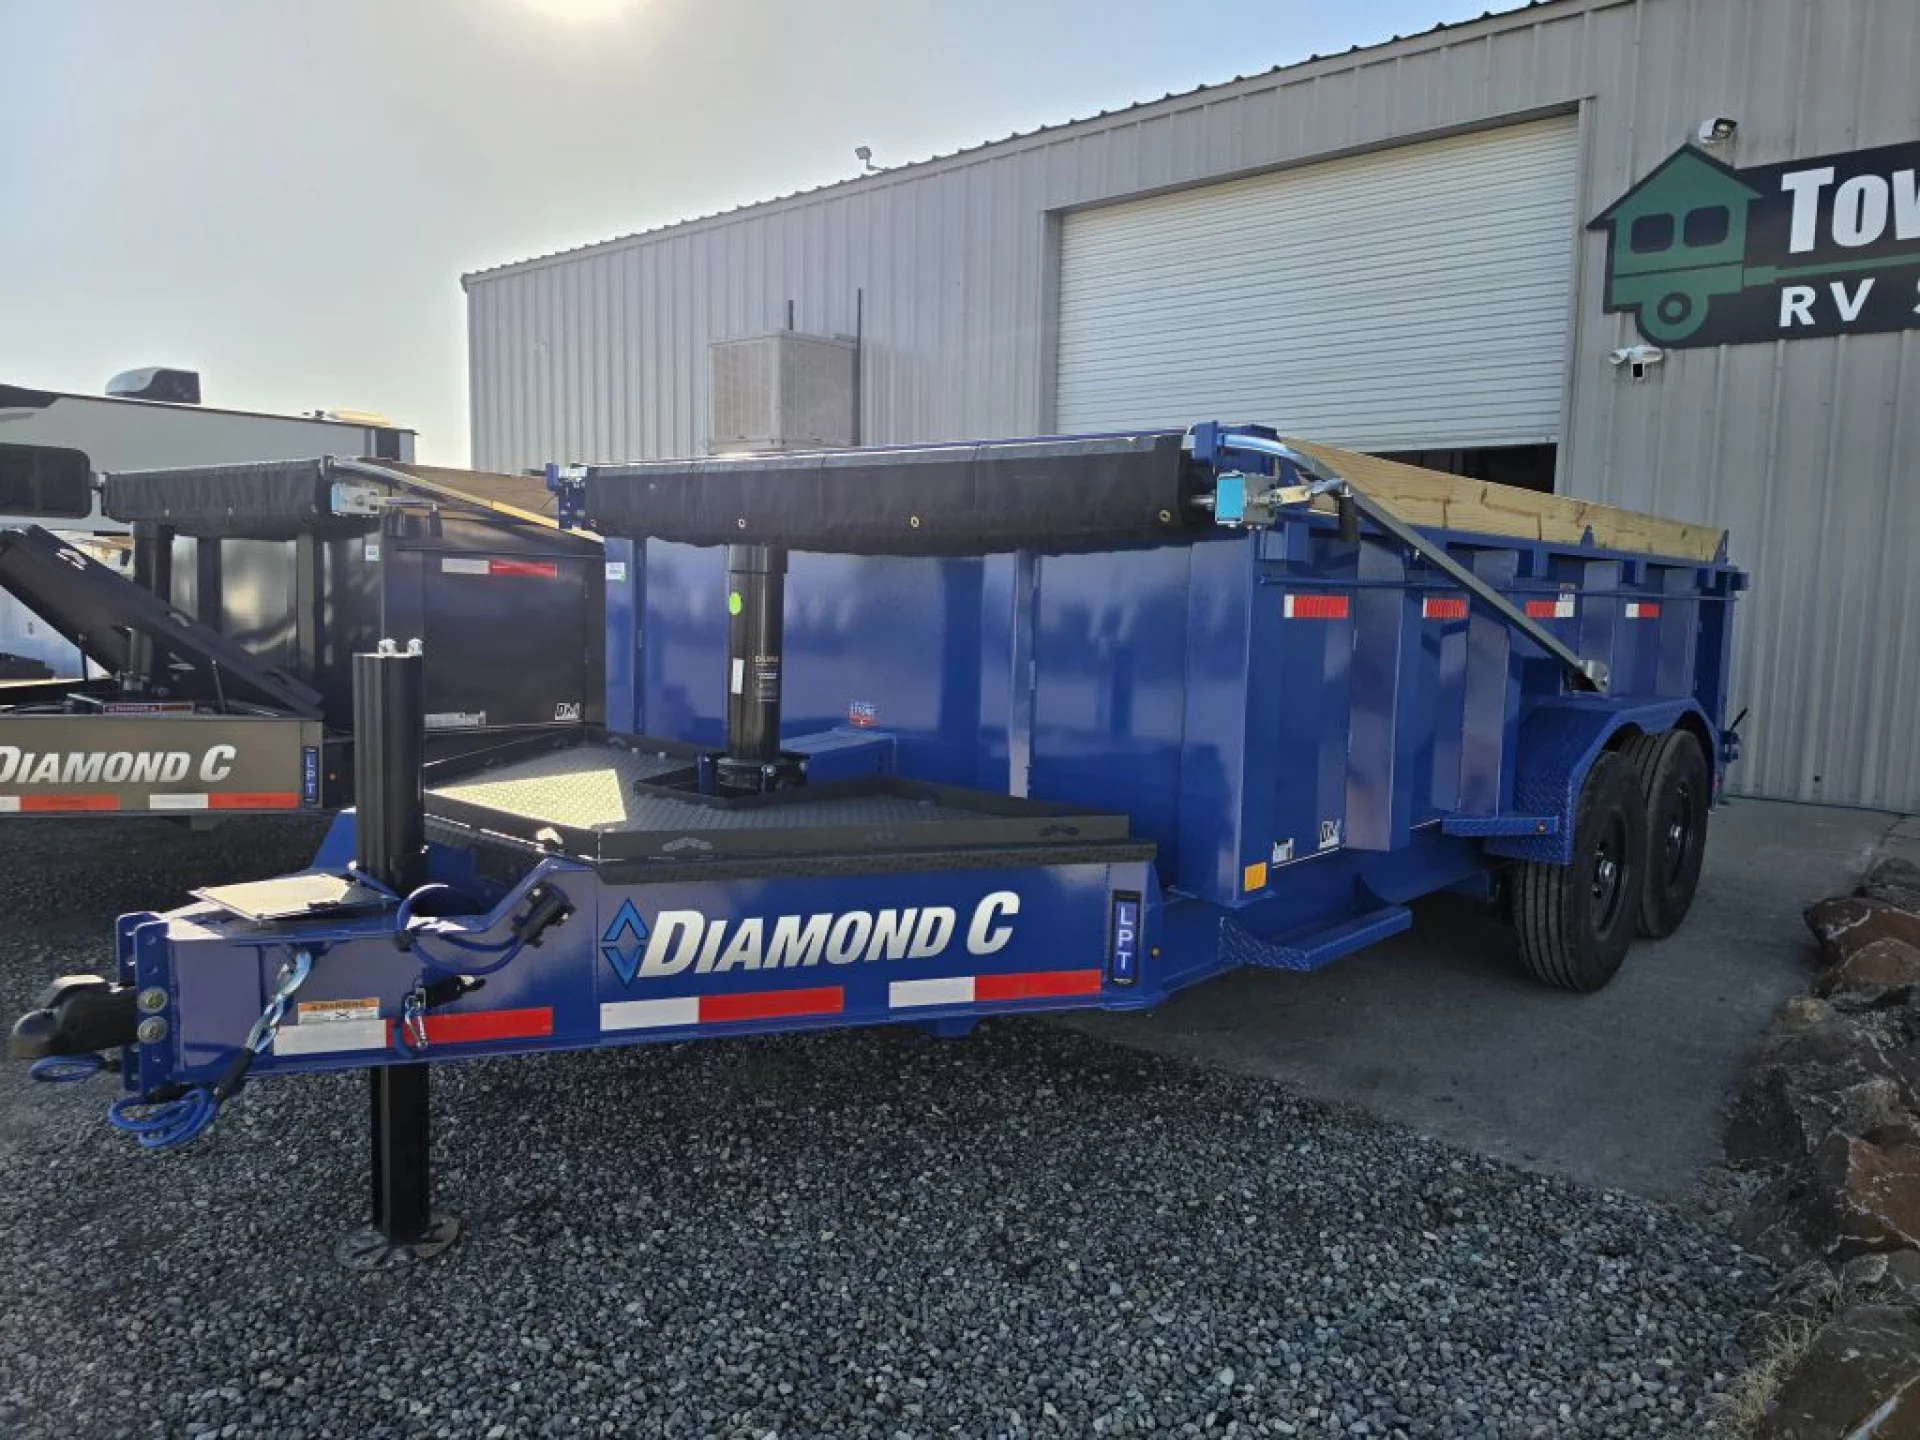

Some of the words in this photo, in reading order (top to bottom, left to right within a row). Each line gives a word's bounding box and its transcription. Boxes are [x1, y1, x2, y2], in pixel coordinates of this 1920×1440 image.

[1778, 278, 1876, 328] RV
[0, 745, 192, 783] DIAMOND
[199, 743, 237, 783] C
[637, 905, 957, 978] DIAMOND
[967, 890, 1020, 956] C
[1116, 904, 1135, 970] LPT
